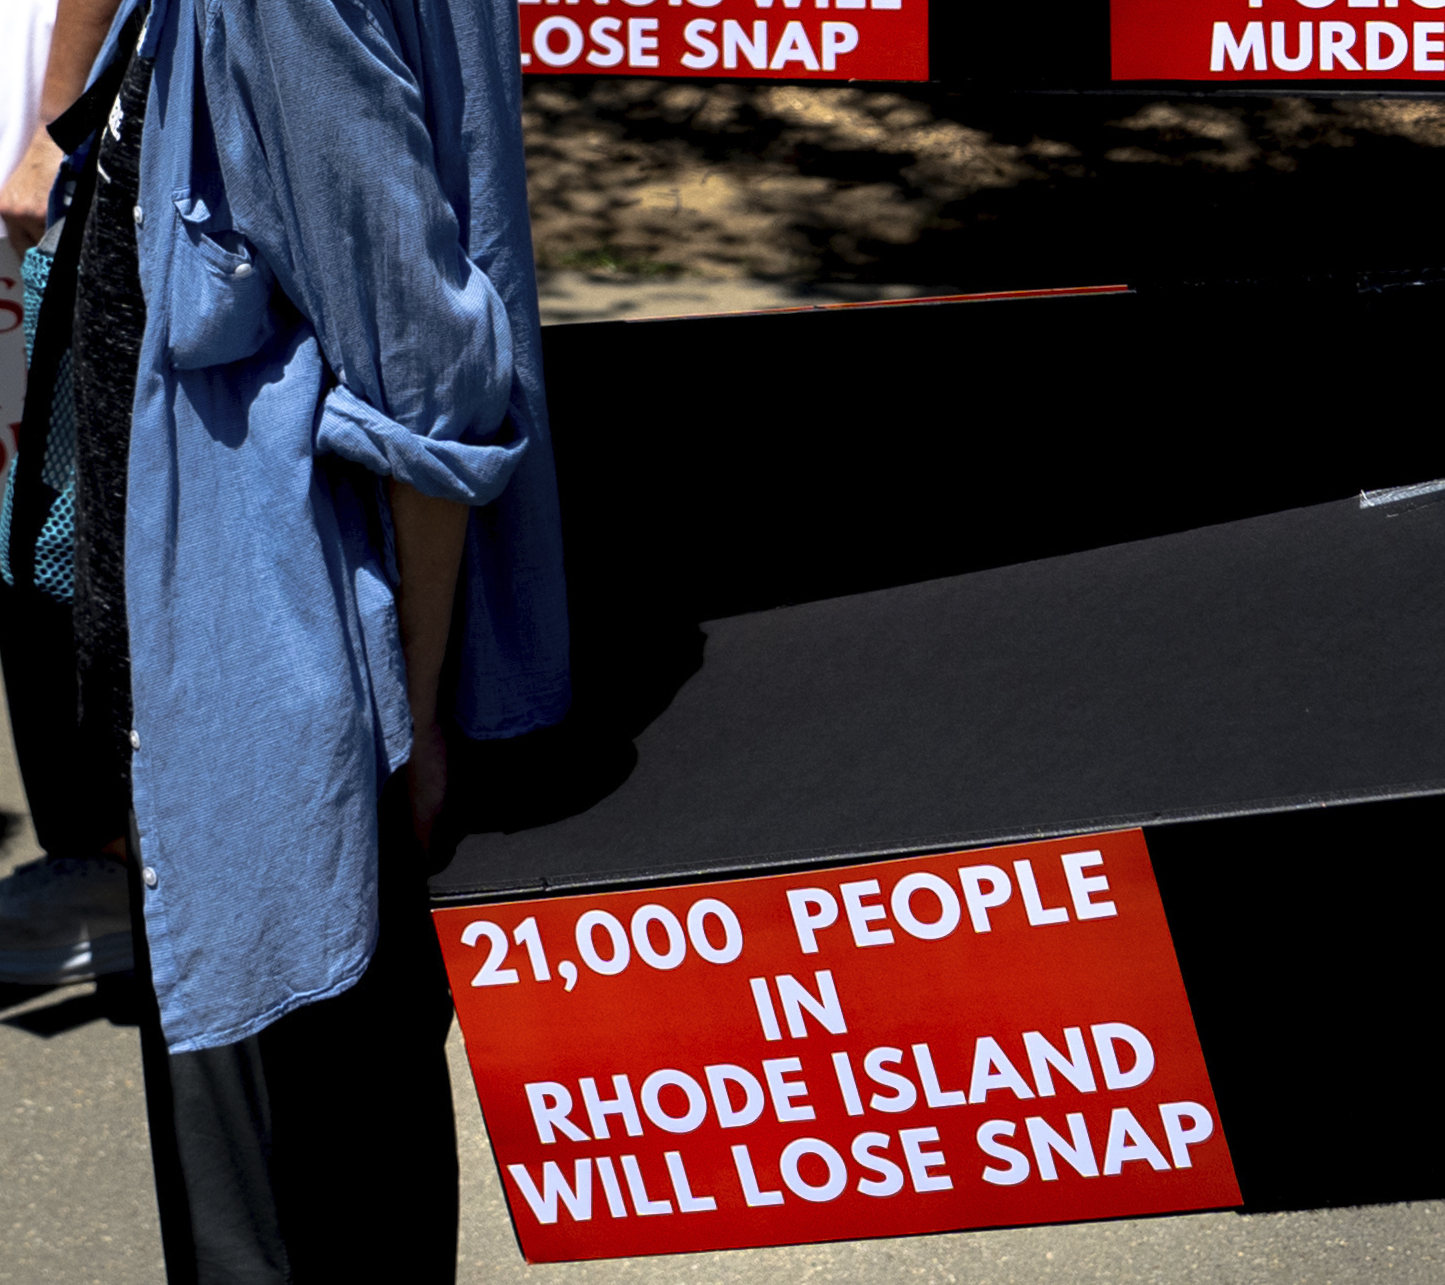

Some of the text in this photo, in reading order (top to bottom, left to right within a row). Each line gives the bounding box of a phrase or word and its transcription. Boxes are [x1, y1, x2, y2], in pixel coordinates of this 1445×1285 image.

[680, 18, 859, 71] SNAP
[461, 850, 1118, 992] 21,000 PEOPLE
[749, 970, 848, 1041] IN
[524, 1022, 1155, 1144] RHODE ISLAND
[507, 1101, 1213, 1224] WILL LOSE SNAP
